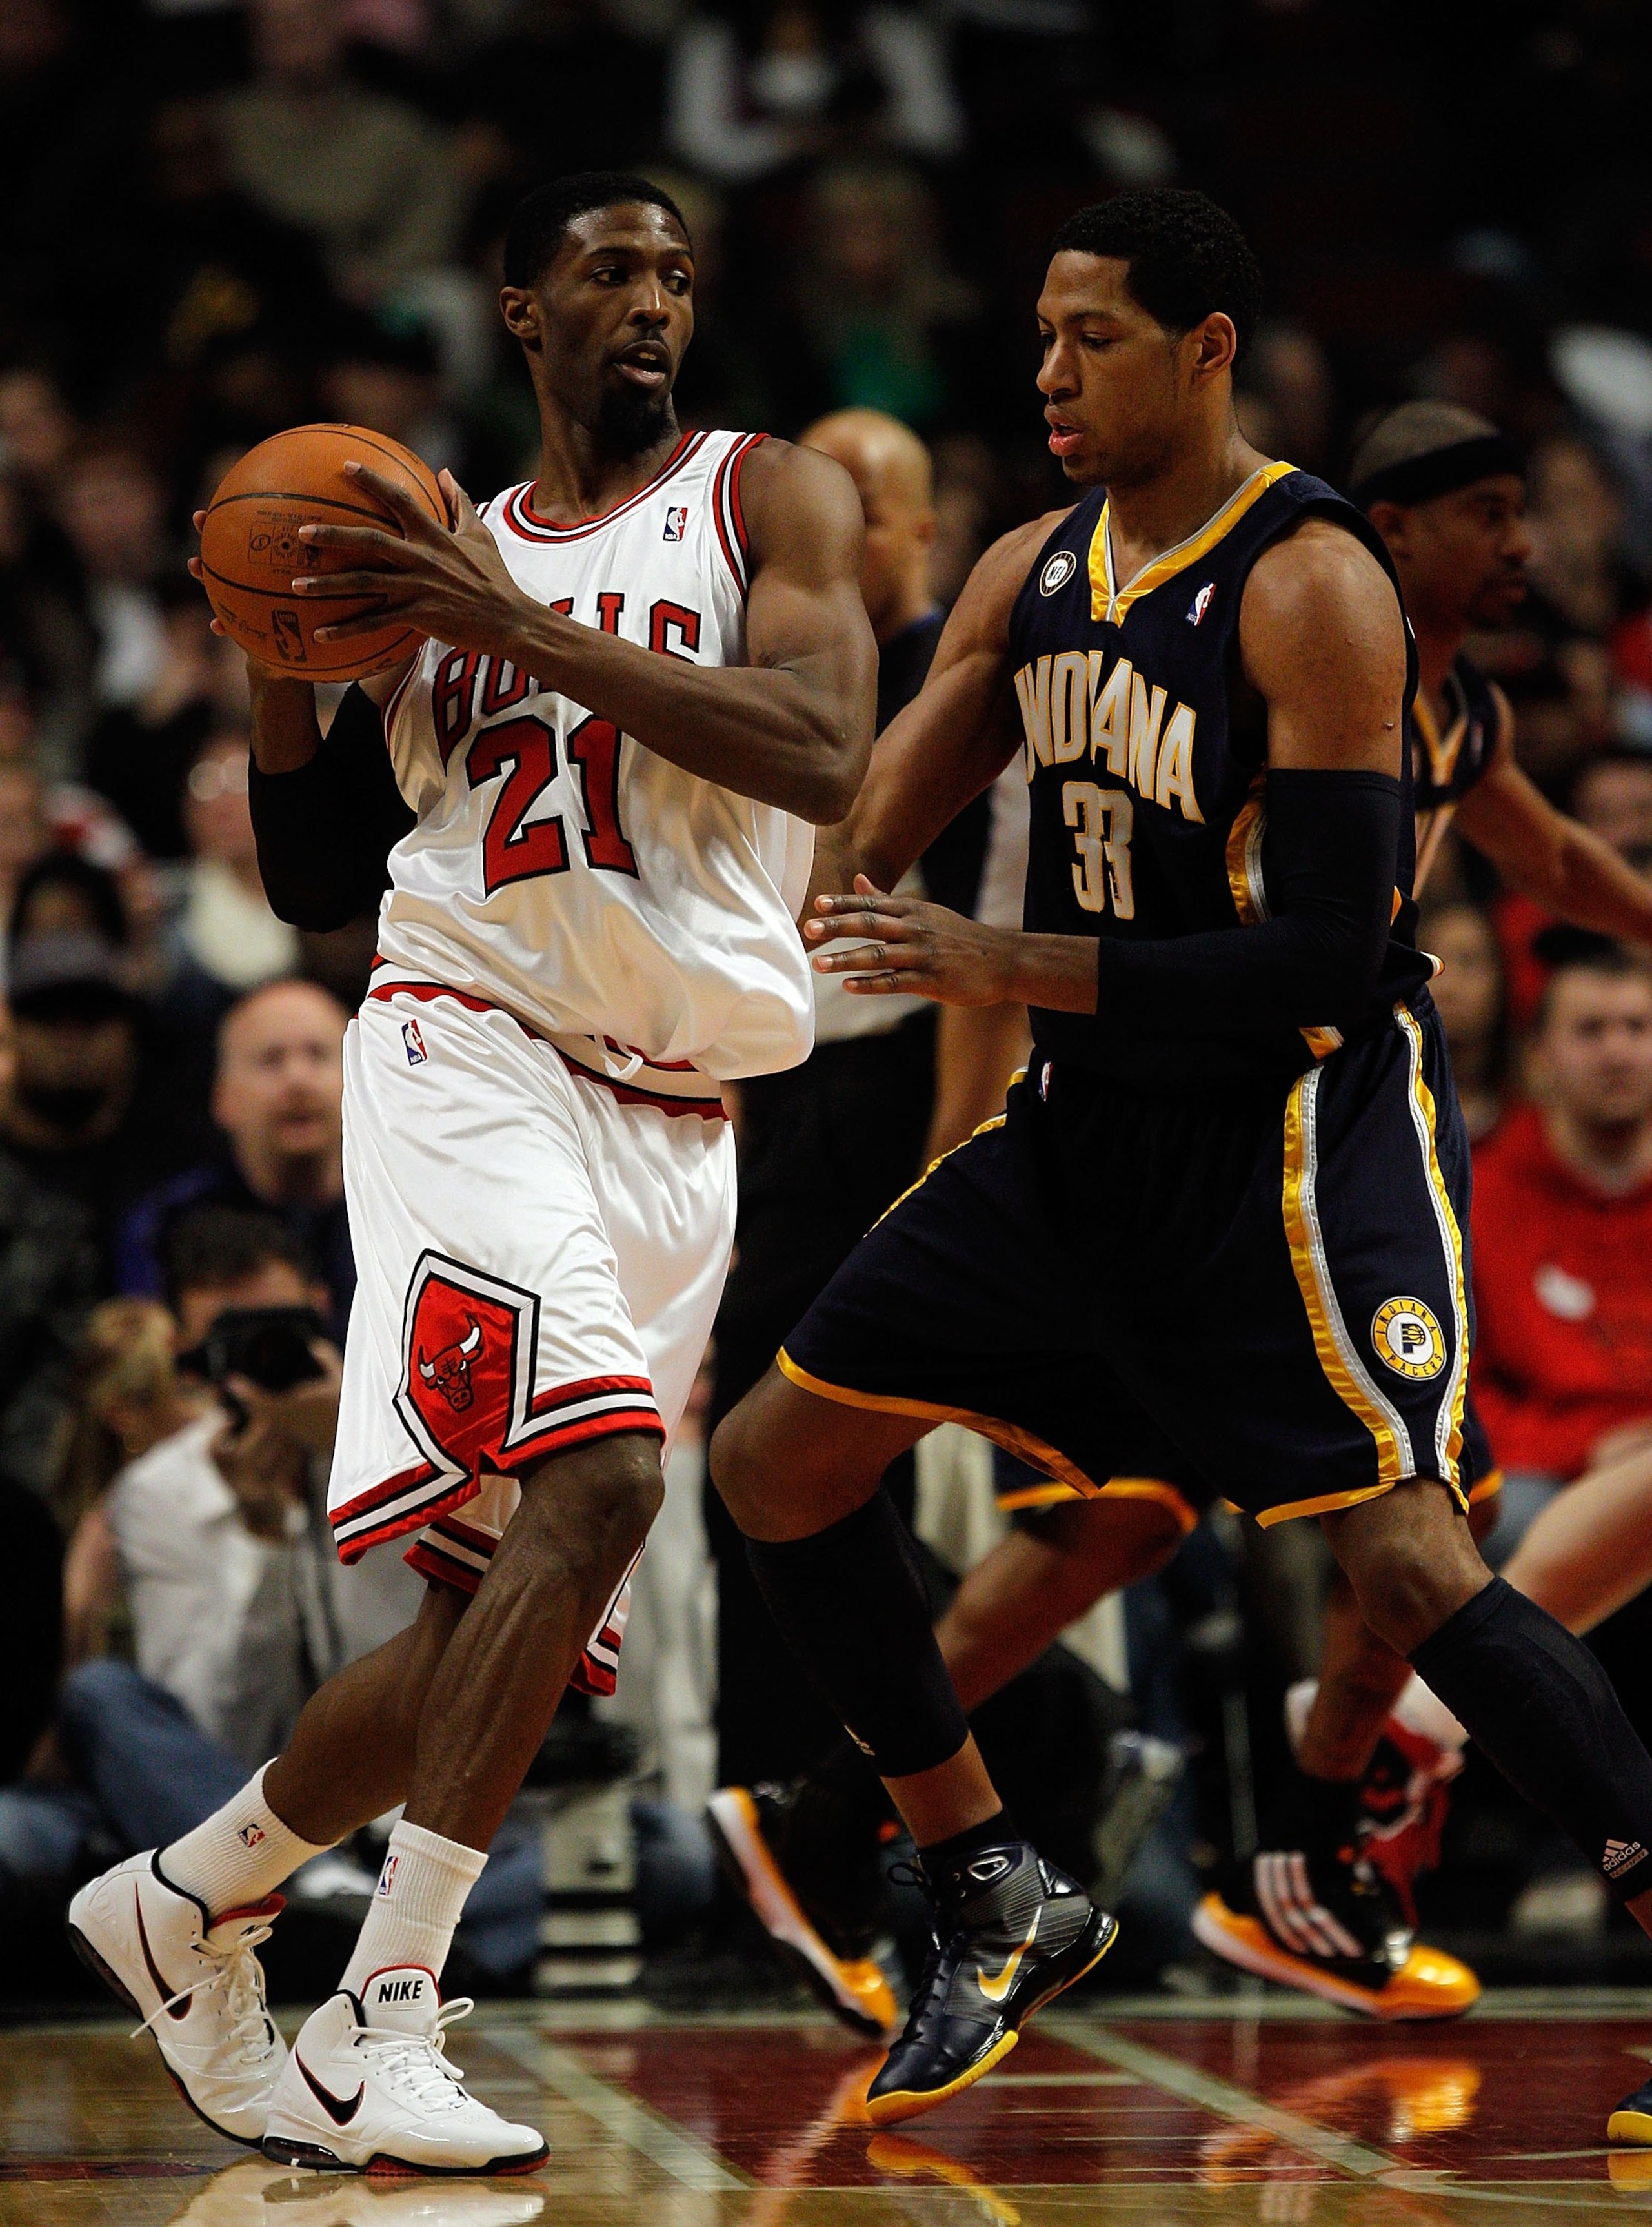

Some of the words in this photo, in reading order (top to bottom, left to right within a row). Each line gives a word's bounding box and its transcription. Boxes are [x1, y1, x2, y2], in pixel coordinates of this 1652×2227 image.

[465, 712, 641, 900] 21
[1062, 781, 1136, 921] 33
[1375, 1301, 1437, 1334] INDIANA
[1387, 1353, 1442, 1376] PACERS
[1603, 1842, 1641, 1871] adidas
[378, 1980, 424, 2004] NIKE
